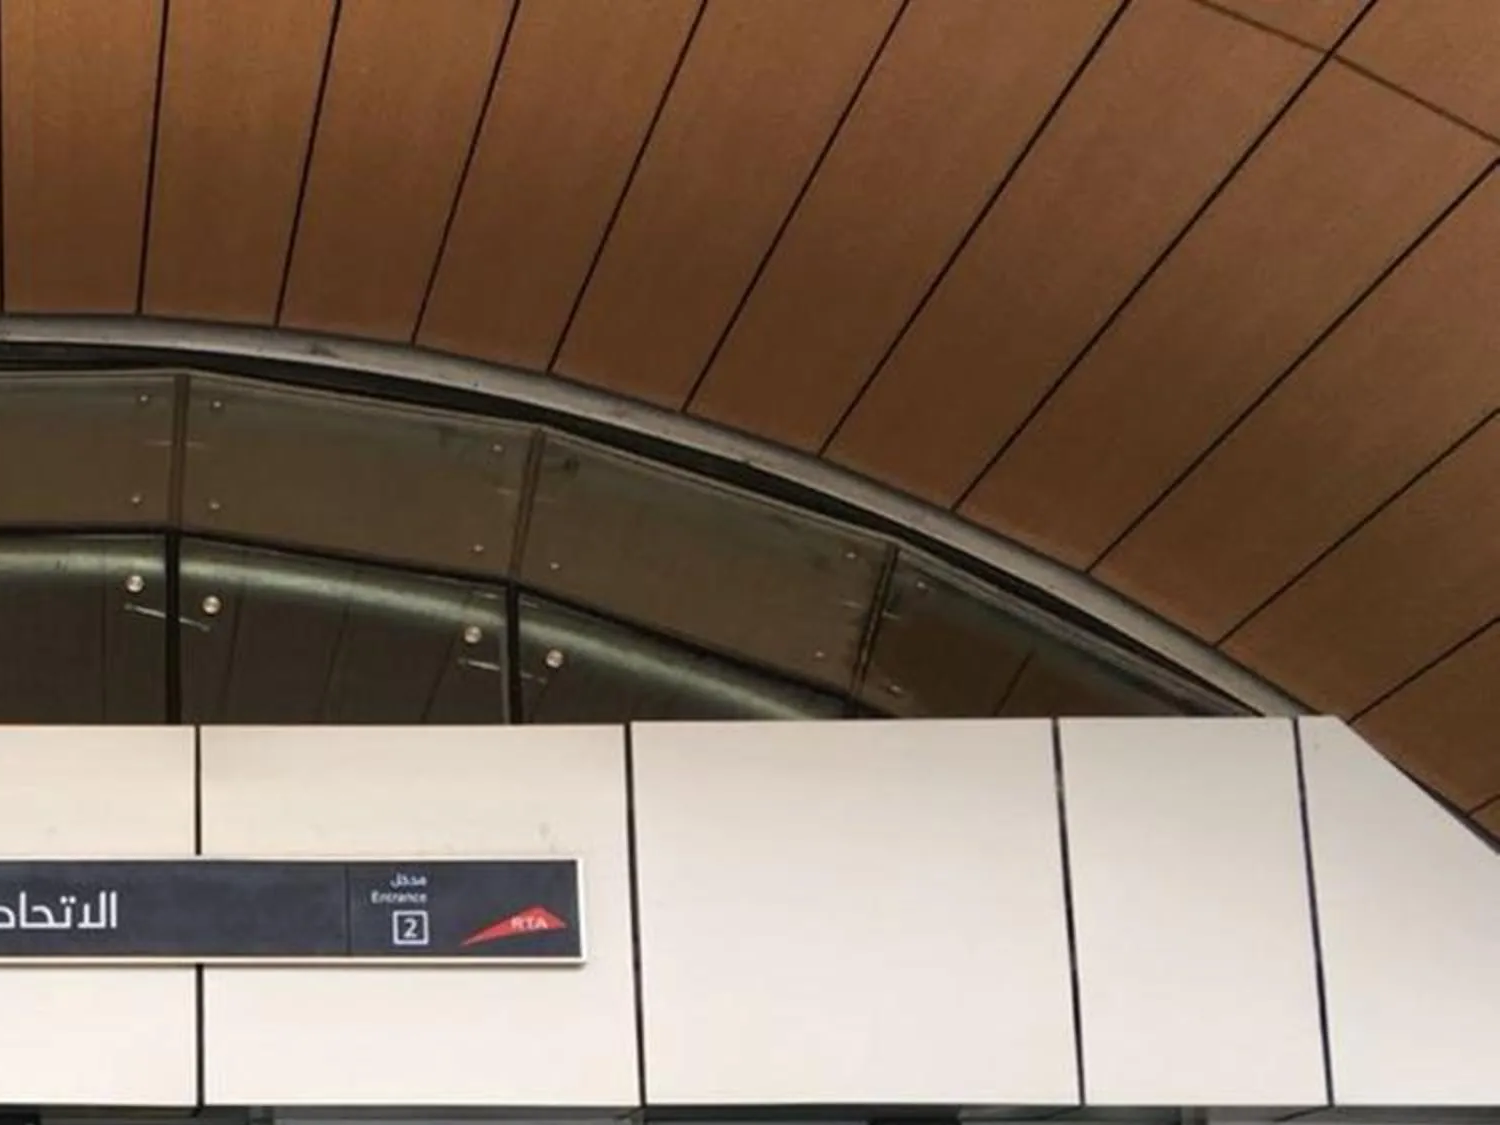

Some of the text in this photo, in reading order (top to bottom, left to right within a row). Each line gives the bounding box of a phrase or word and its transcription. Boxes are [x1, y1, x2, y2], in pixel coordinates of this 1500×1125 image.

[390, 873, 427, 888] مدخل
[370, 891, 427, 904] Entrance
[403, 917, 418, 939] 2
[510, 915, 548, 930] RTA
